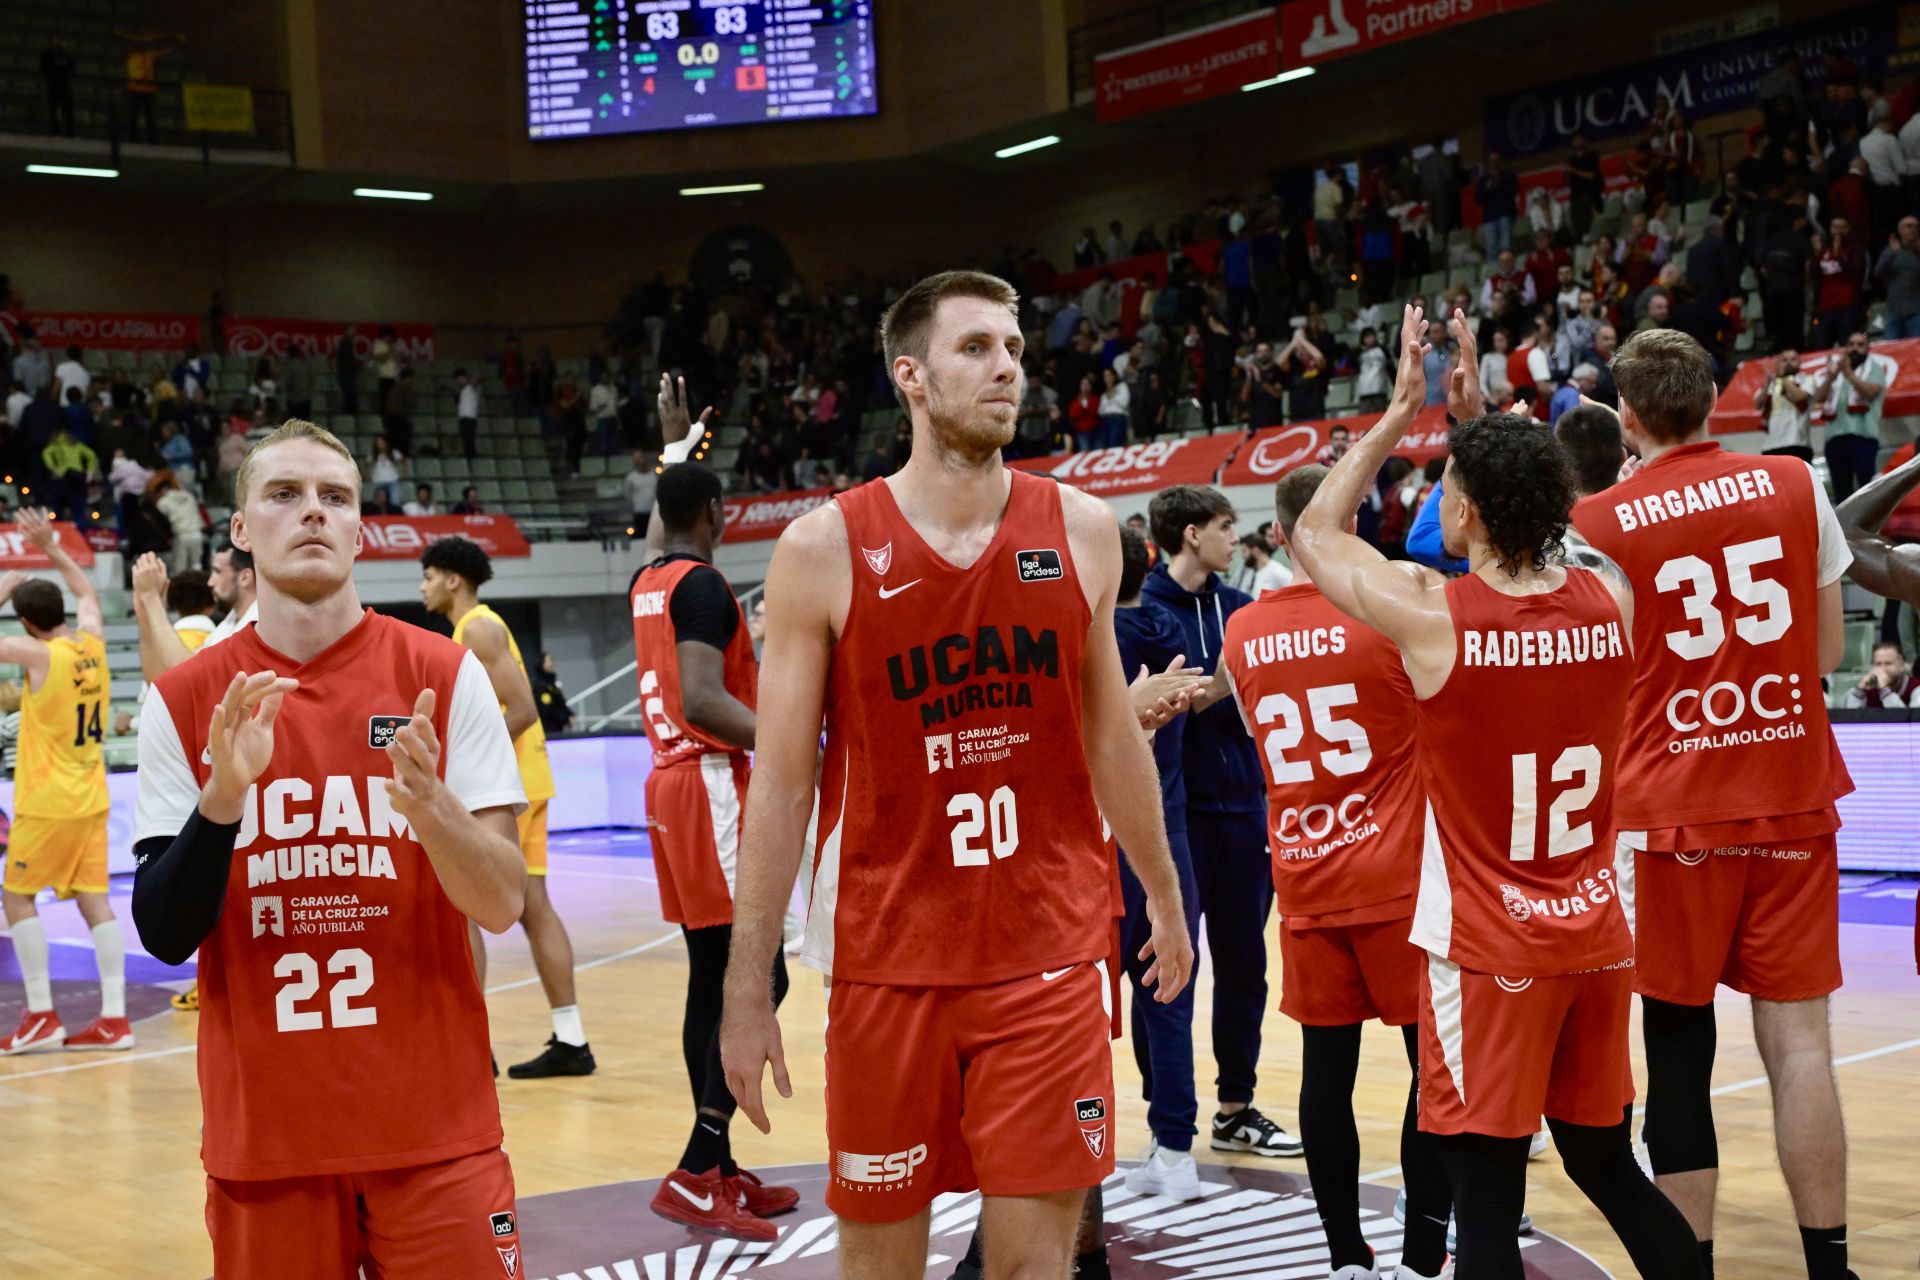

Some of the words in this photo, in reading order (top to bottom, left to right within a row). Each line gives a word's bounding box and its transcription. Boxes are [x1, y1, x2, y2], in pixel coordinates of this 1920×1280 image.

[646, 12, 680, 40] 63
[714, 7, 748, 35] 83
[1366, 0, 1473, 41] Partners
[677, 42, 720, 66] 0.0
[98, 319, 187, 340] CARRILLO
[1615, 469, 1775, 533] BIRGANDER
[1022, 560, 1039, 572] liga
[1024, 567, 1060, 578] endesa
[1655, 535, 1793, 661] 35
[1244, 626, 1345, 668] KURUCS
[1464, 621, 1624, 667] RADEBAUGH
[887, 625, 1059, 702] UCAM
[920, 682, 1033, 730] MURCIA
[74, 701, 103, 746] 14
[374, 725, 394, 736] liga
[958, 724, 1008, 740] CARAVACA
[1255, 683, 1373, 785] 25
[1668, 721, 1806, 754] OFTALMOLOGÍA
[959, 743, 973, 752] DE
[975, 741, 986, 750] LA
[986, 737, 1006, 749] CRUZ
[1008, 733, 1030, 745] 2024
[960, 752, 982, 765] AÑO
[983, 748, 1011, 764] JUBILAR
[1510, 744, 1602, 861] 12
[946, 785, 1019, 867] 20
[247, 844, 398, 889] MURCIA
[1753, 846, 1768, 857] DE
[1771, 850, 1812, 861] MURCIA
[290, 895, 359, 907] CARAVACA
[292, 910, 306, 921] DE
[309, 909, 323, 920] LA
[325, 908, 357, 919] CRUZ
[360, 906, 389, 917] 2024
[292, 922, 316, 935] AÑO
[319, 921, 365, 935] JUBILAR
[273, 948, 377, 1032] 22
[1080, 1106, 1099, 1118] acb
[837, 1143, 928, 1183] ESP
[836, 1177, 913, 1192] SOLUTIONS
[496, 1221, 512, 1234] acb
